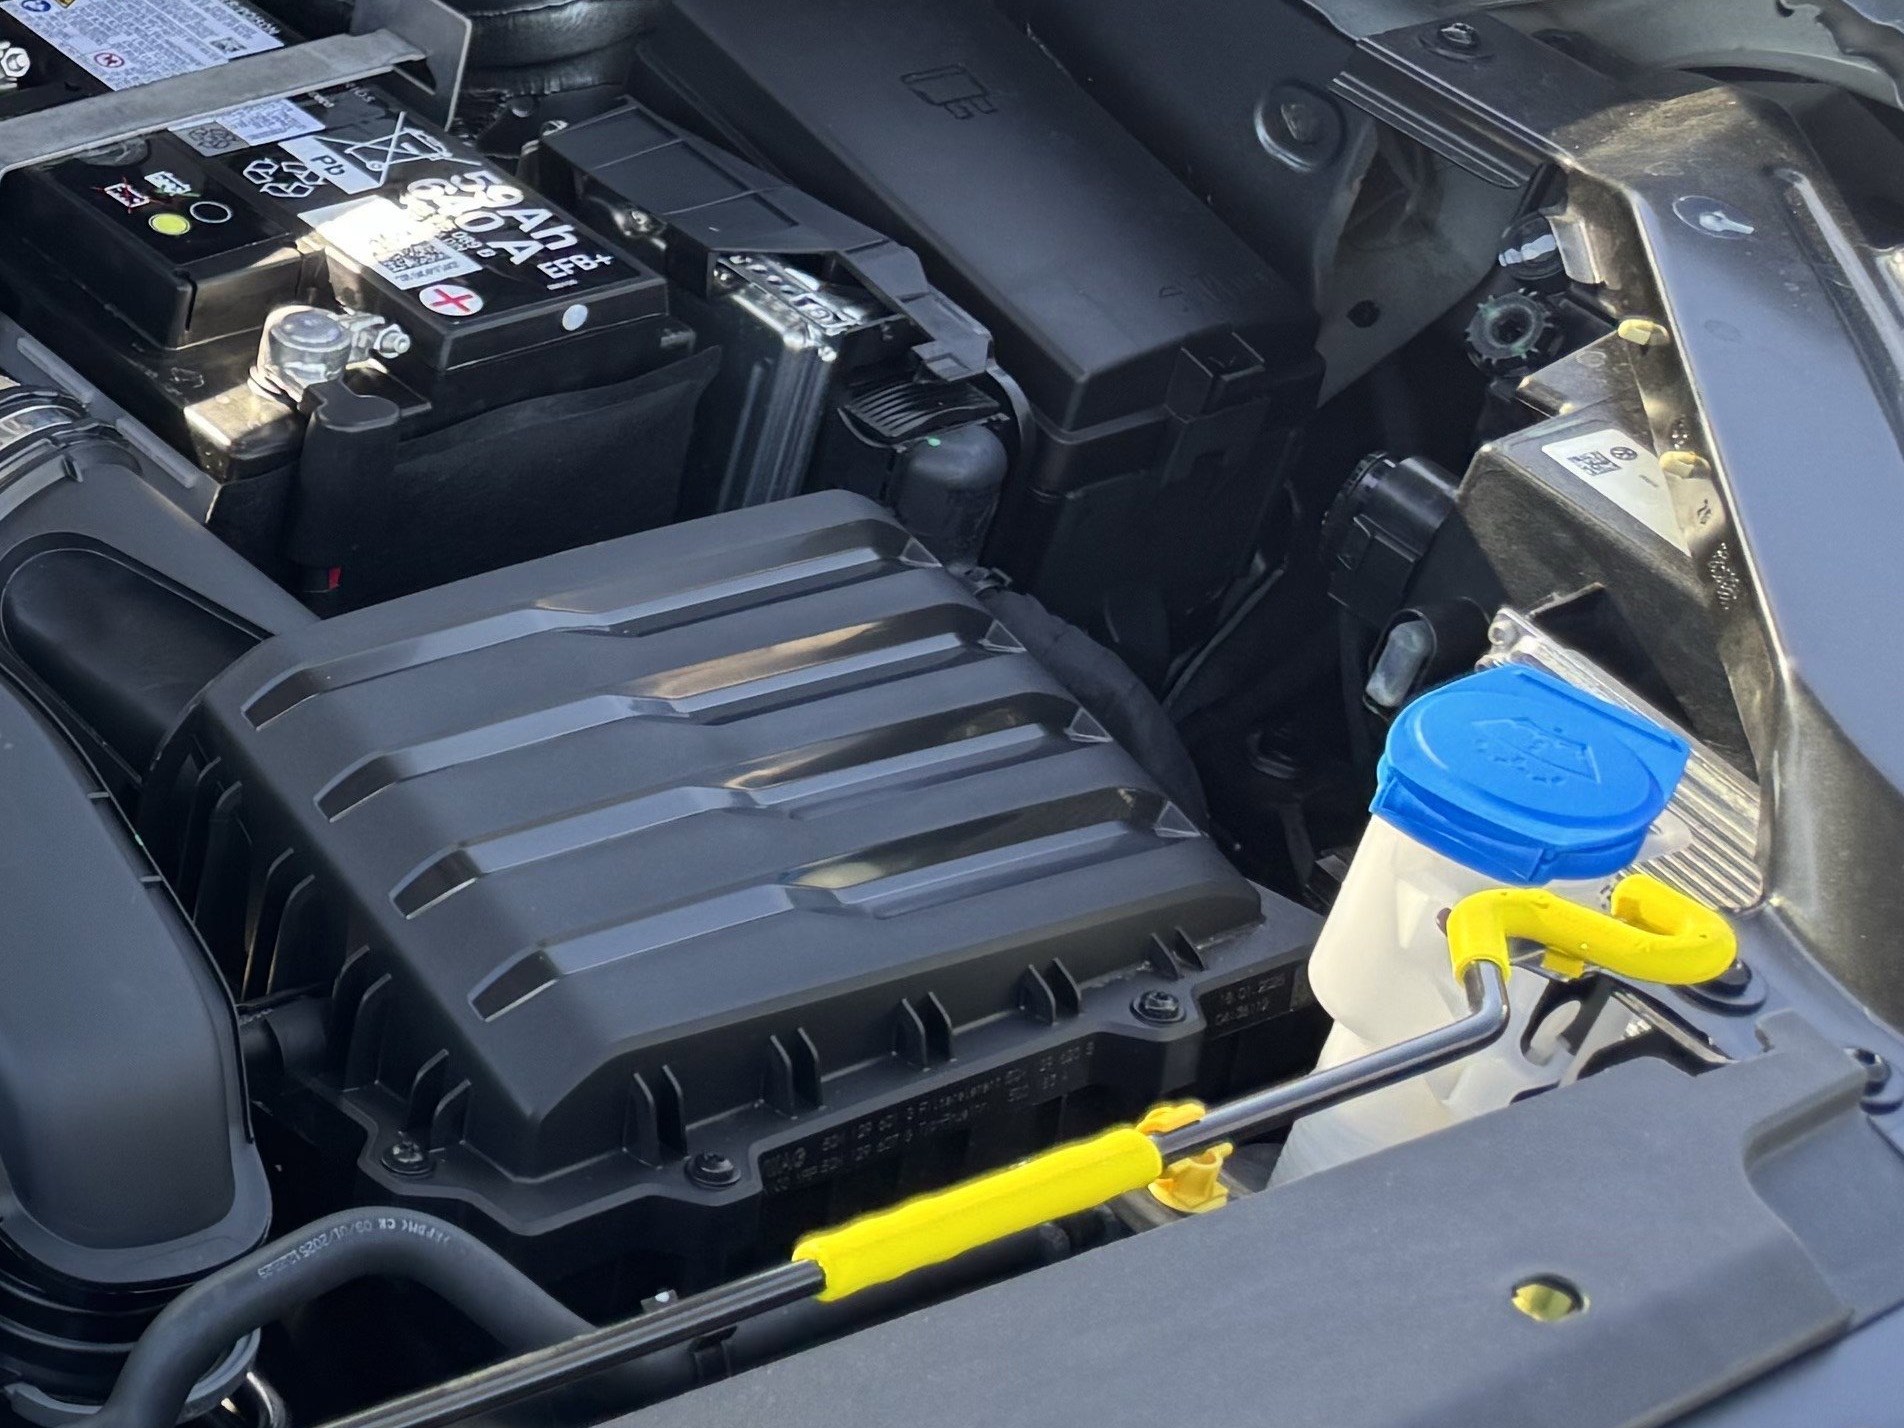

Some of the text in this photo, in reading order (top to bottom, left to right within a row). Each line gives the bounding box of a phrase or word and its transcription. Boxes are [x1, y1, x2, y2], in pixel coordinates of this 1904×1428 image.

[309, 154, 346, 177] Pb
[488, 234, 545, 266] A
[537, 251, 615, 280] EFB+
